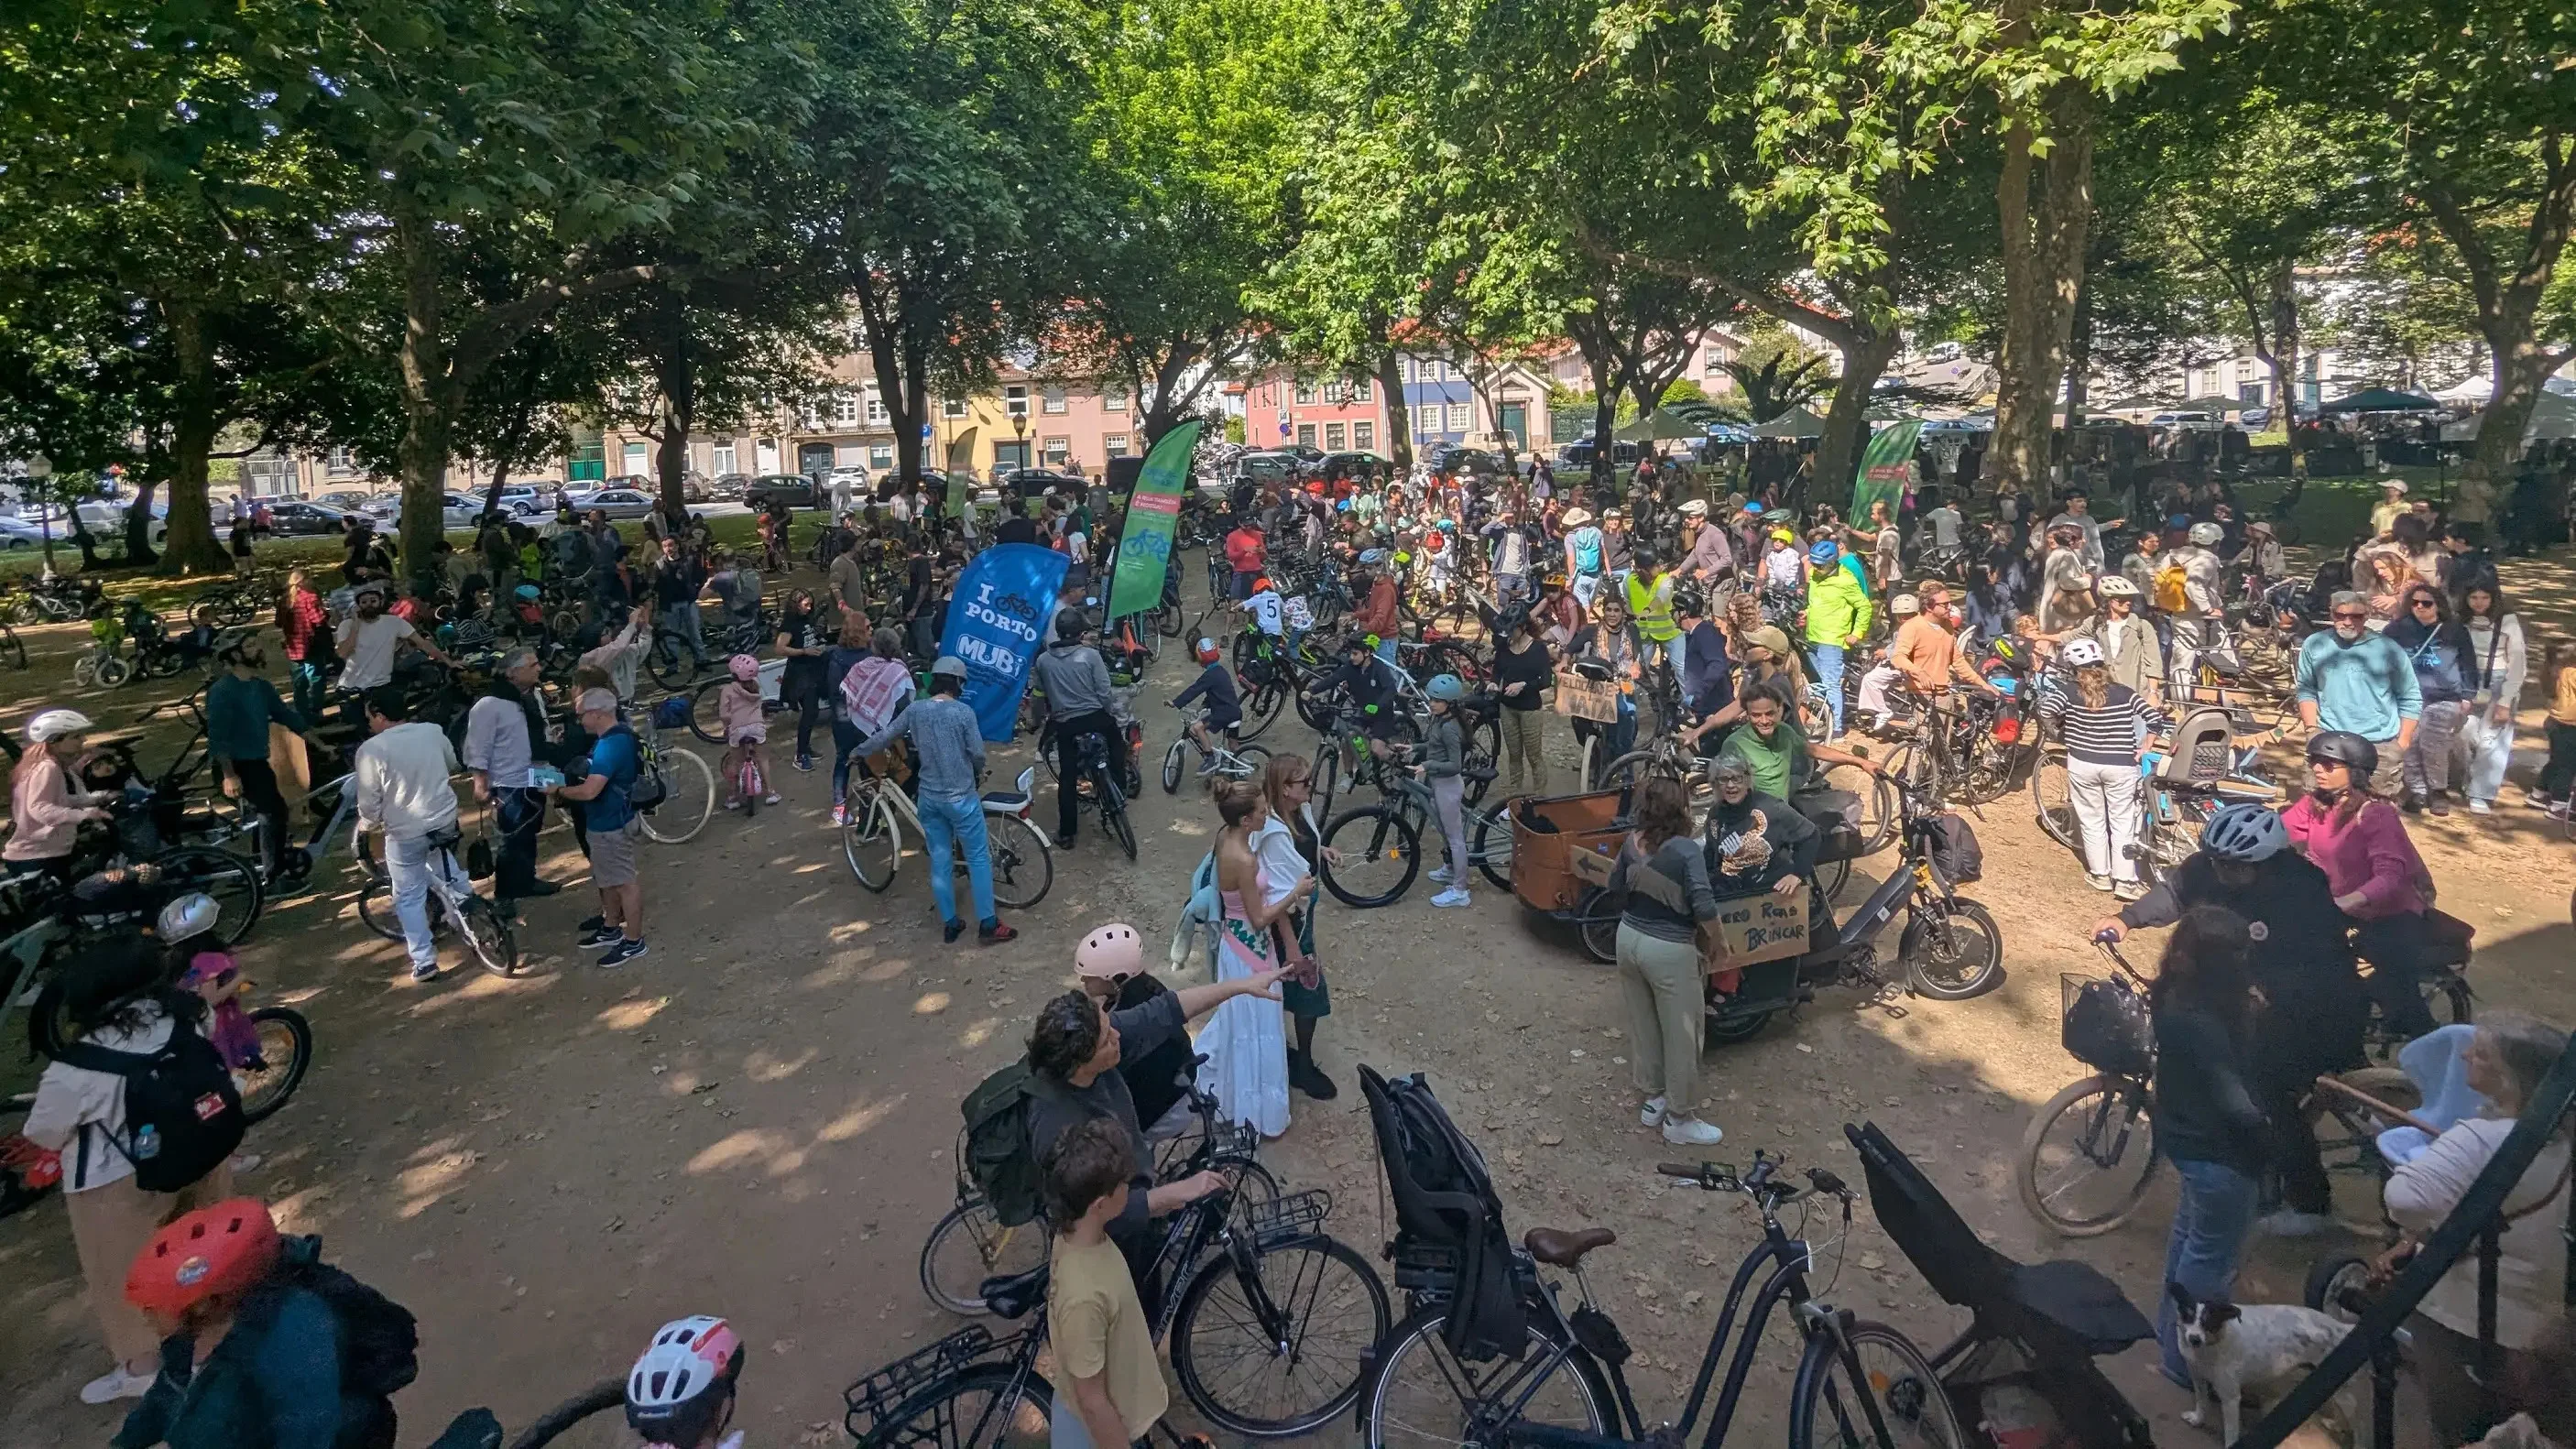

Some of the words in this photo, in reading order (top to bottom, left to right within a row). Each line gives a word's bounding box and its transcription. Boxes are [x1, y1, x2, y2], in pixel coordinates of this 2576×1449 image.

[977, 583, 994, 605] I
[1267, 599, 1277, 619] 5
[965, 602, 1037, 642] PORTO
